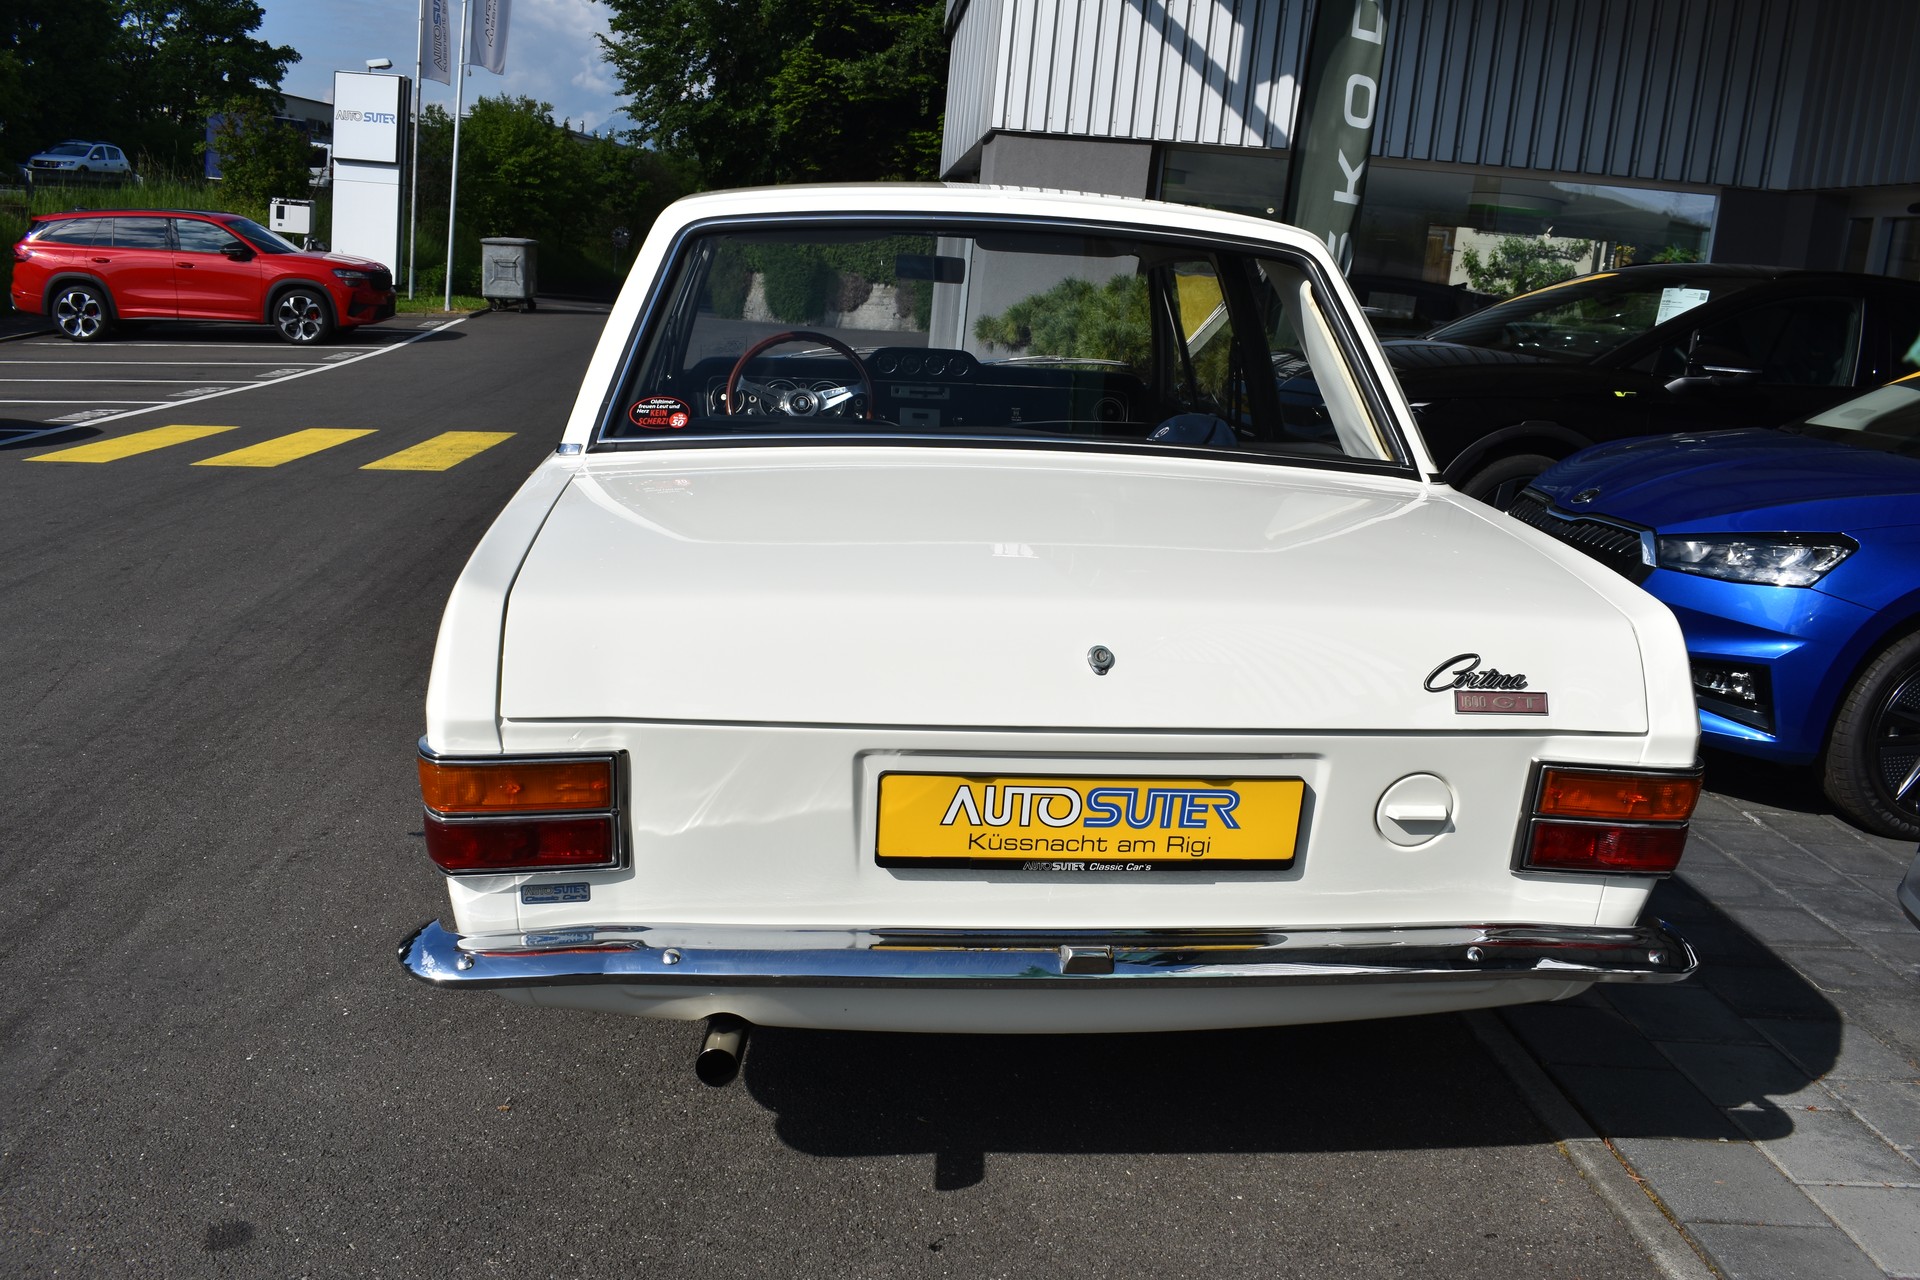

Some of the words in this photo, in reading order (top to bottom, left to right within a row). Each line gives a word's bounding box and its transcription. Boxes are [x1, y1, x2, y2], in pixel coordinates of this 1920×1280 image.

[335, 109, 363, 122] AUTO
[363, 111, 396, 124] SUTER
[650, 409, 668, 417] KEIN
[671, 419, 685, 427] 50
[1423, 653, 1528, 692] Cortina
[968, 833, 1108, 853] Küssnacht
[1117, 839, 1156, 853] am
[1166, 836, 1211, 857] Rigi
[1089, 862, 1123, 871] Classic
[1125, 862, 1152, 871] Car's
